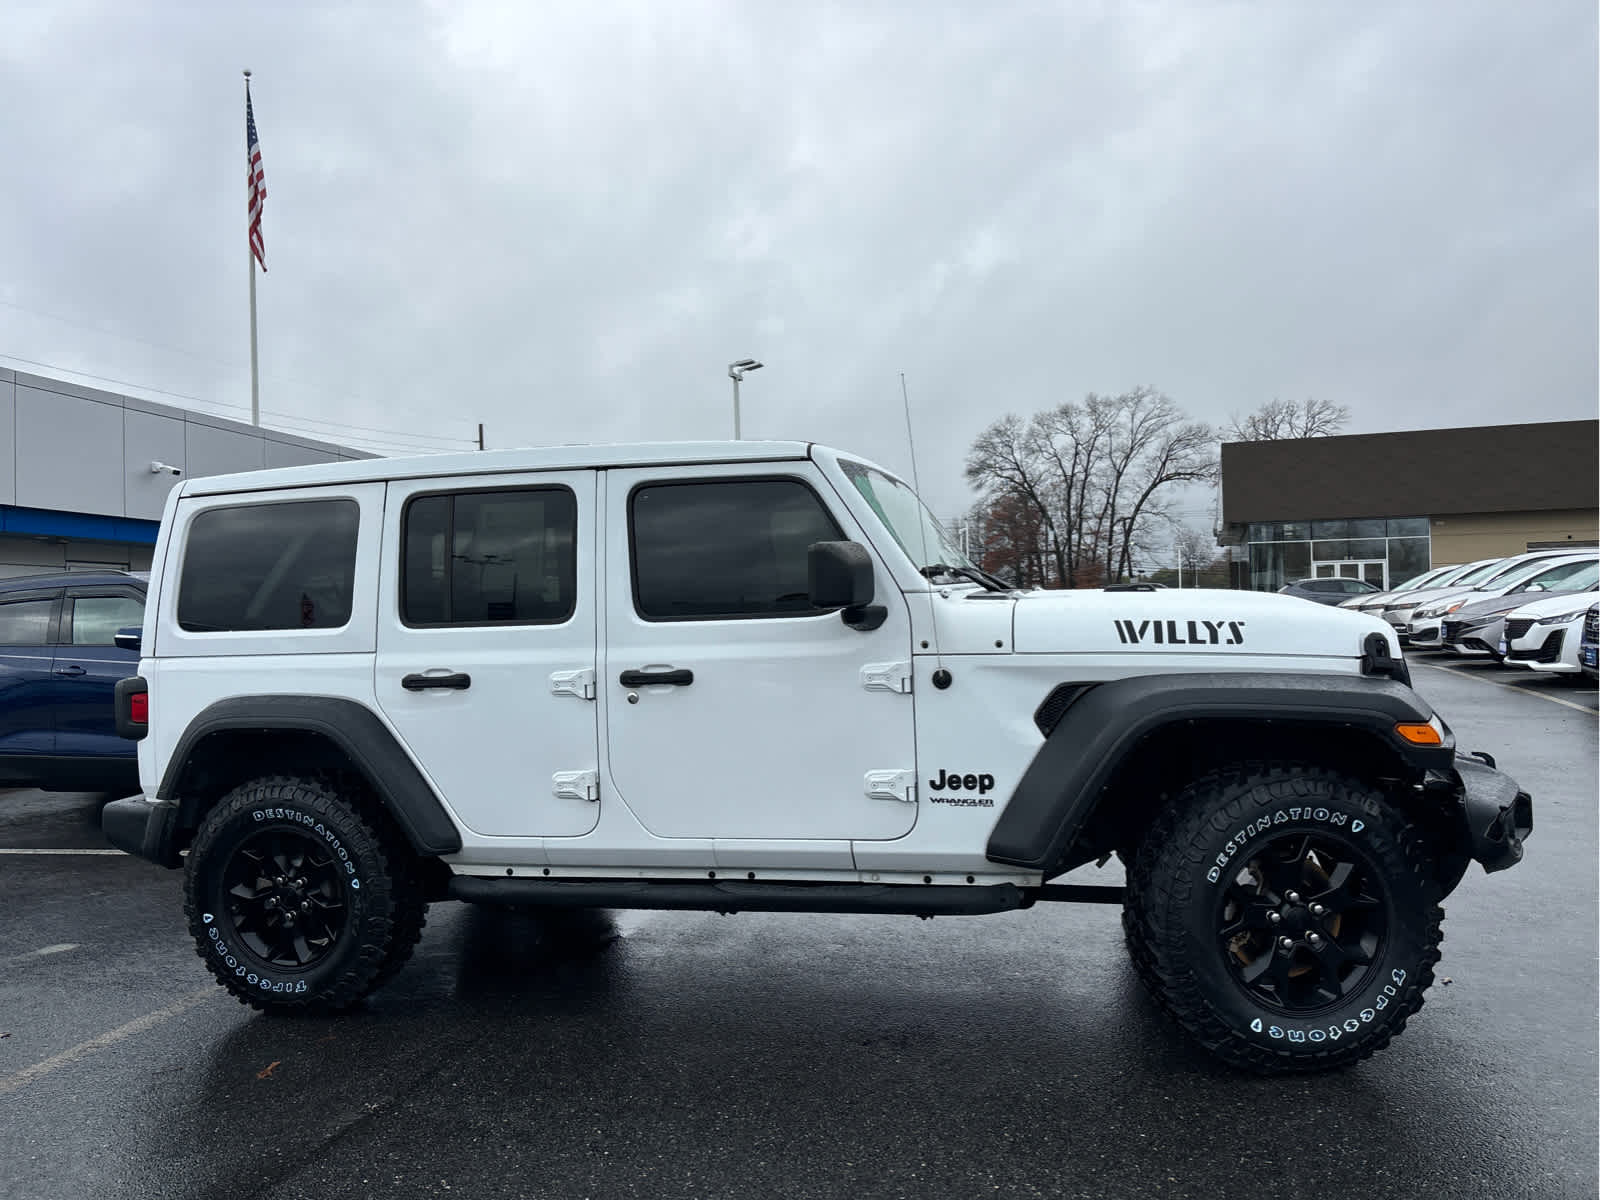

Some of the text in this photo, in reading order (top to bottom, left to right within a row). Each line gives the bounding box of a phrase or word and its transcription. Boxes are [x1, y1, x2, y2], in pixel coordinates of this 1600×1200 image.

[1114, 620, 1245, 644] WILLYS
[929, 769, 994, 794] Jeep
[253, 808, 355, 874] DESTINATION
[1207, 807, 1347, 883] DESTINATION
